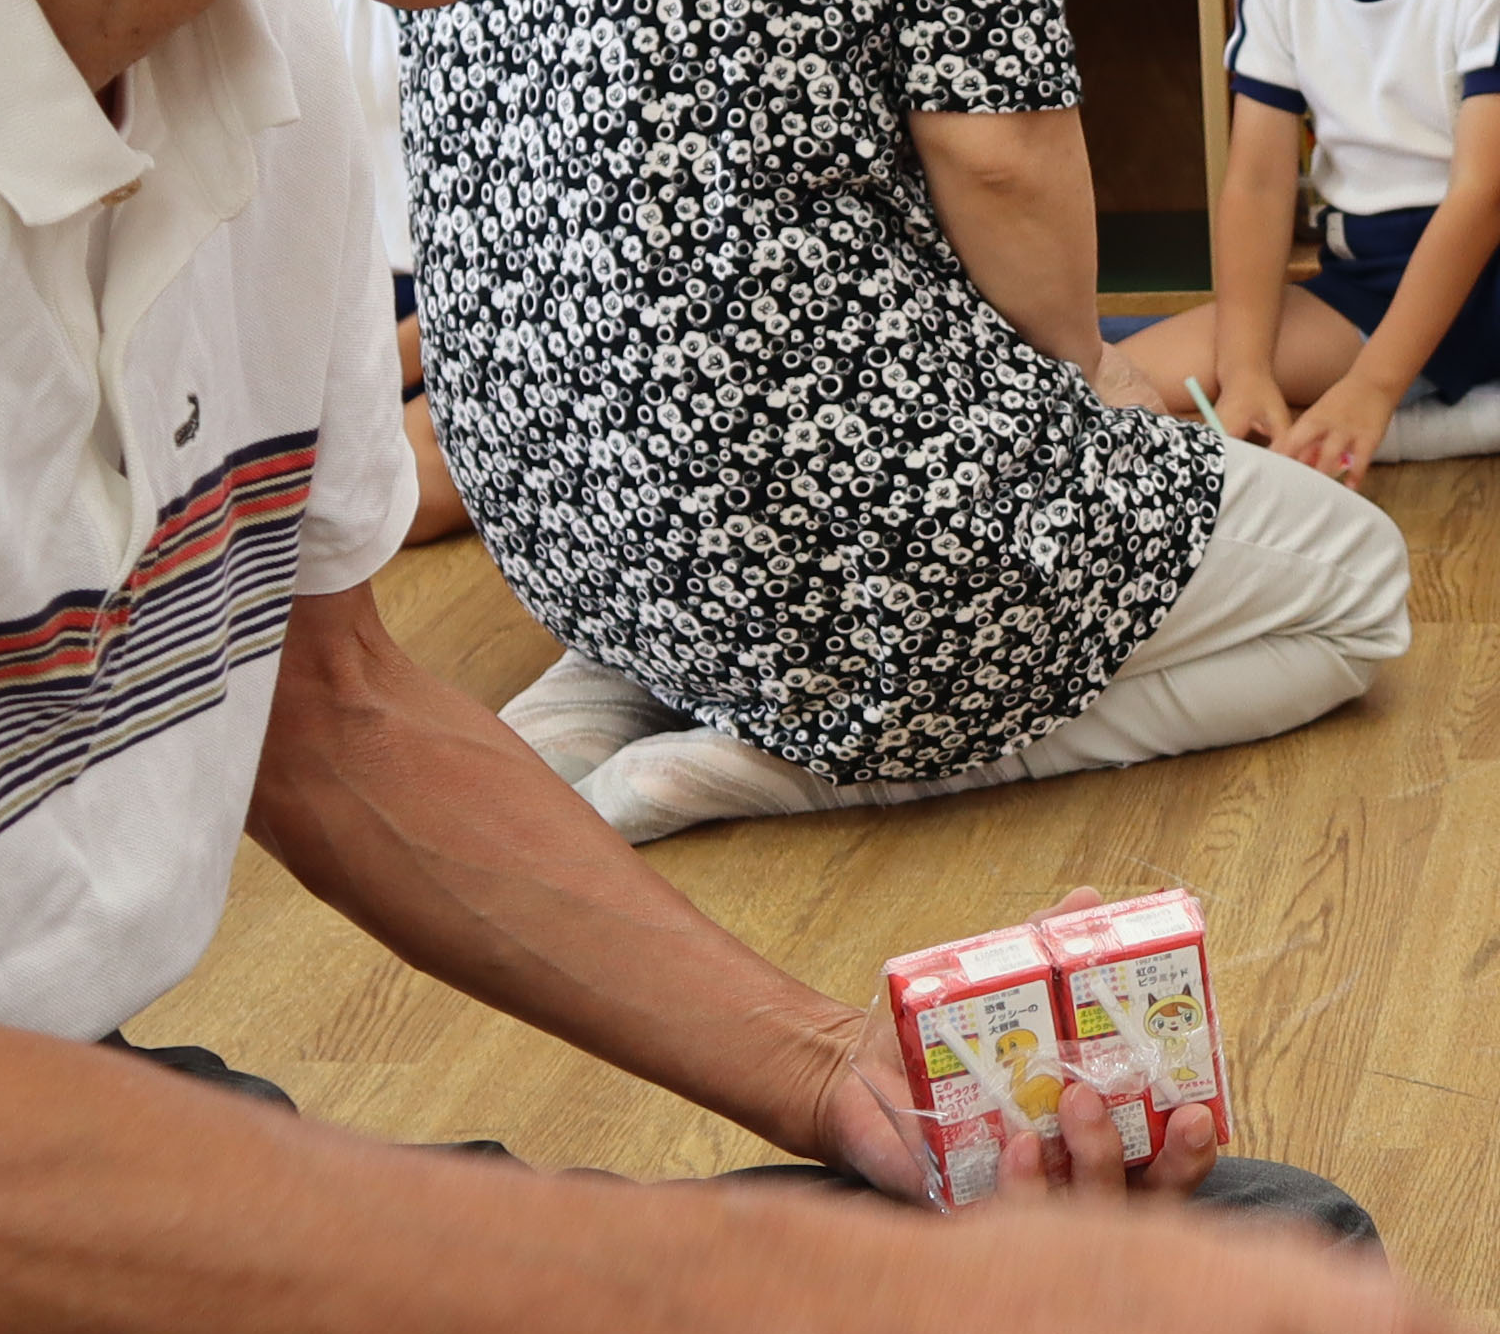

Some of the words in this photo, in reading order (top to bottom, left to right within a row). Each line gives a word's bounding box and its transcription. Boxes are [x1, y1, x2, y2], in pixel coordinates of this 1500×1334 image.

[1136, 966, 1157, 978] 虹の
[1138, 968, 1189, 987] ピラミッド
[984, 1002, 1007, 1014] 恐竜
[988, 1004, 1039, 1025] ノッシーの
[989, 1019, 1021, 1035] 大冒険
[935, 1081, 953, 1094] この
[937, 1083, 982, 1103] キャラクタ
